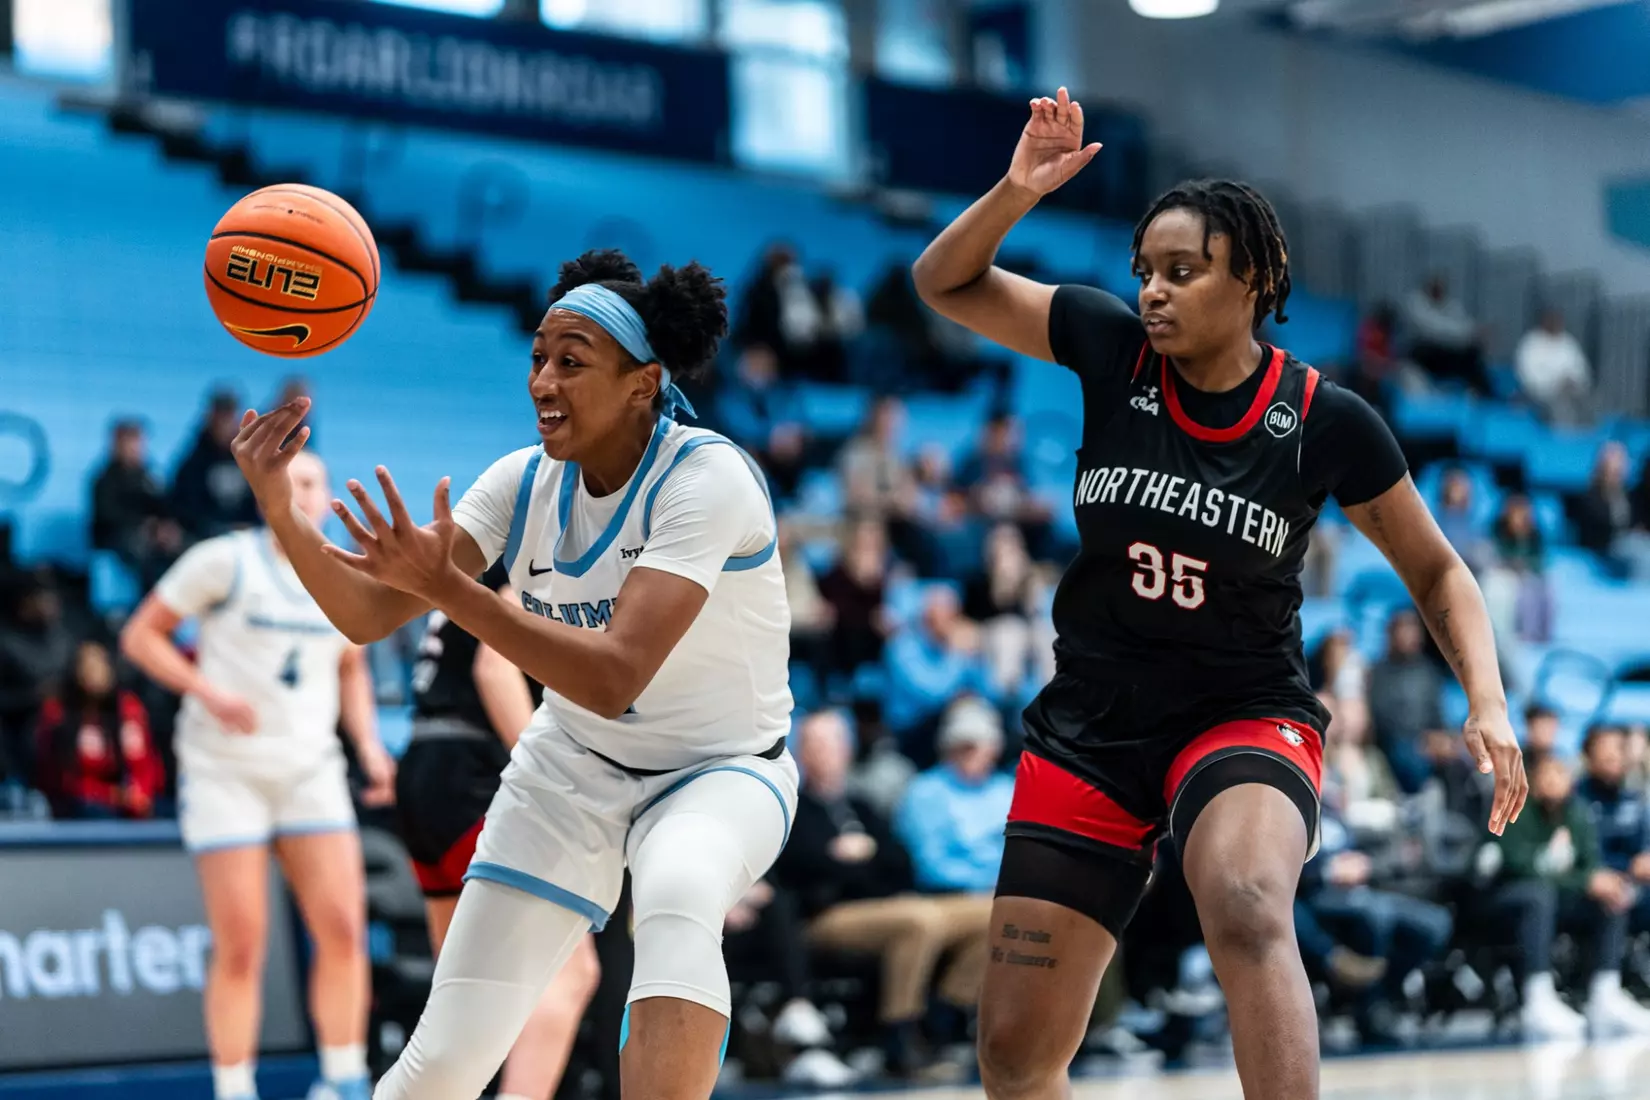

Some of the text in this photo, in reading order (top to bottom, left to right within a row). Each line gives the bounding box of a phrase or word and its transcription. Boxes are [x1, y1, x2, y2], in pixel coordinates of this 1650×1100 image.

[226, 251, 321, 301] ELITE
[1269, 411, 1292, 429] BLM
[1075, 467, 1289, 558] NORTHEASTERN
[1128, 541, 1209, 610] 35
[521, 590, 618, 628] COLUM
